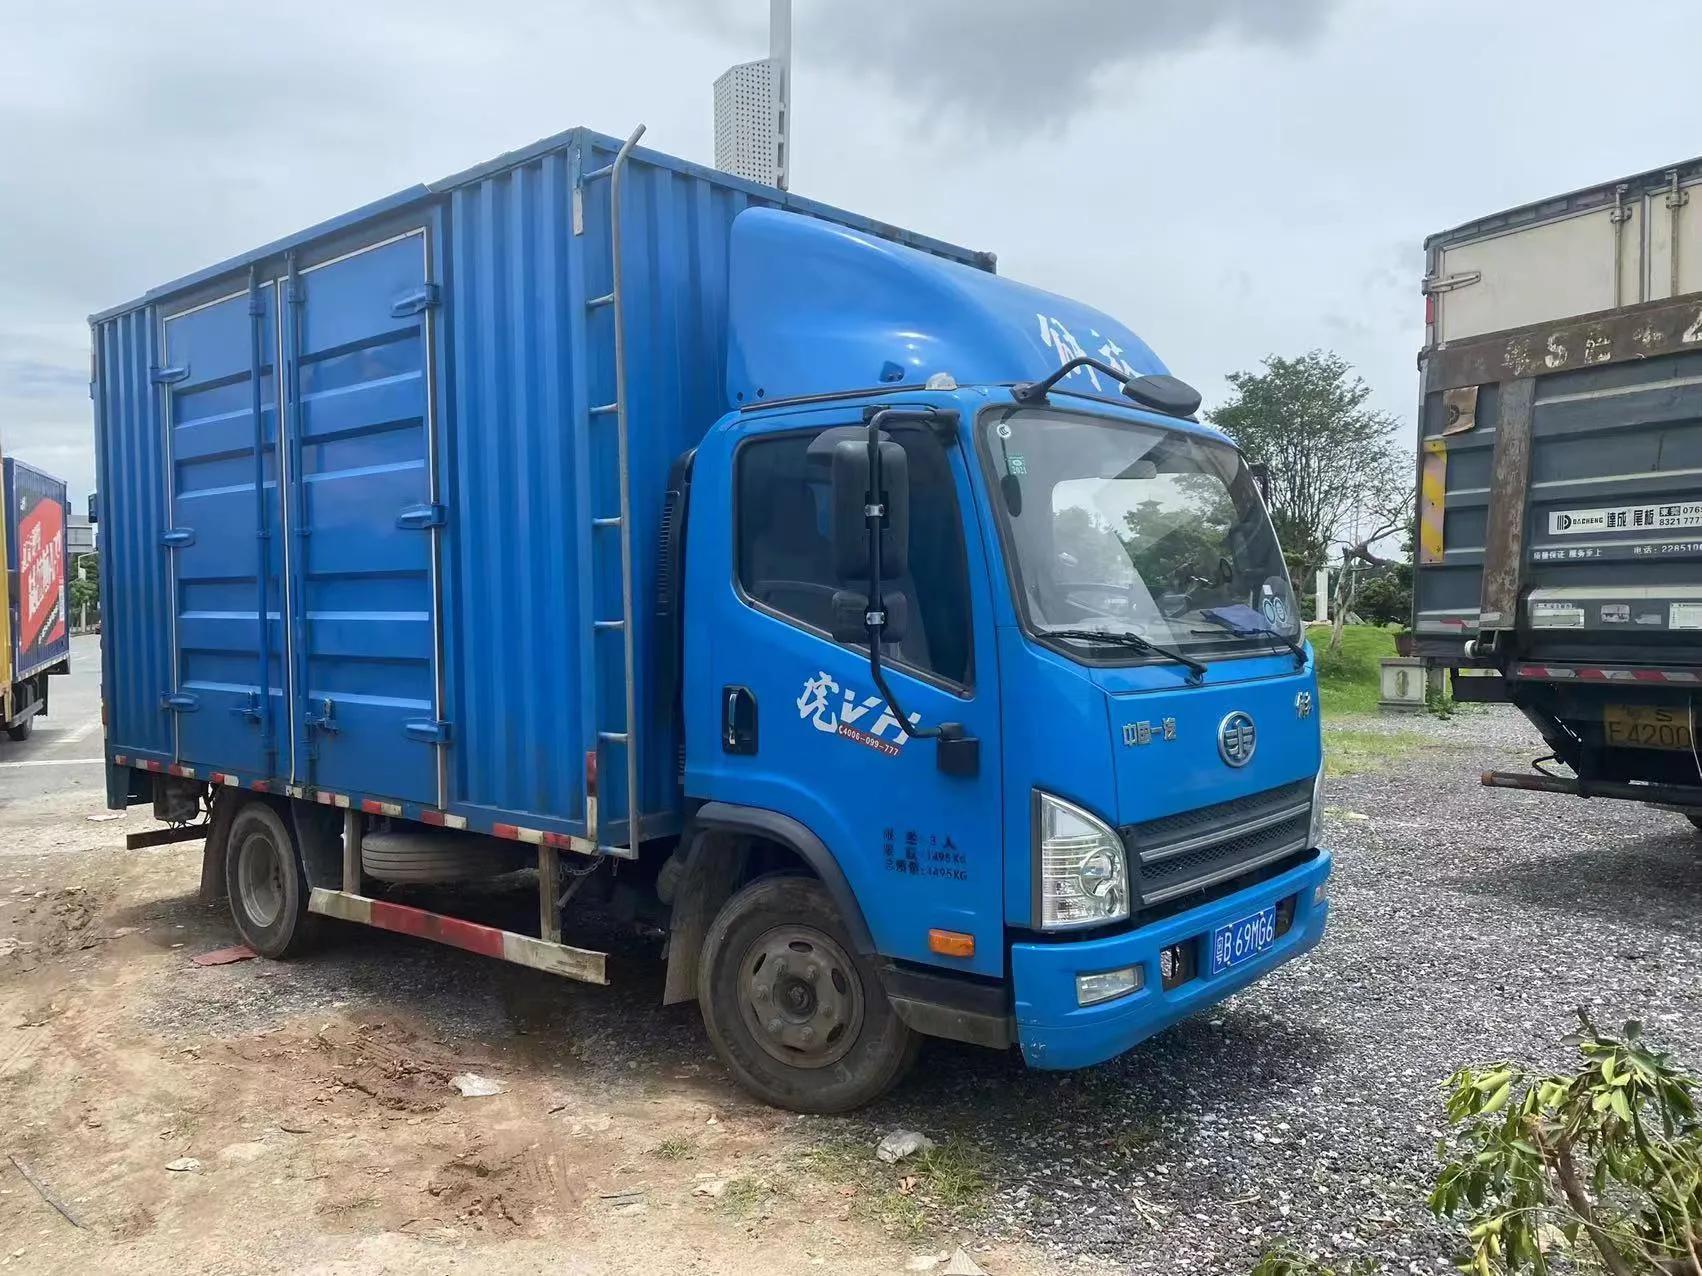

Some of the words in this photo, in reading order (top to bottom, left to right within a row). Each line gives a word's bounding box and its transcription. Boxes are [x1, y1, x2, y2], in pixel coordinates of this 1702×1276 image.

[1683, 506, 1702, 514] 076
[1659, 517, 1681, 526] 8321
[842, 726, 900, 756] 4006-099-777
[1122, 717, 1177, 747] 中国一汽
